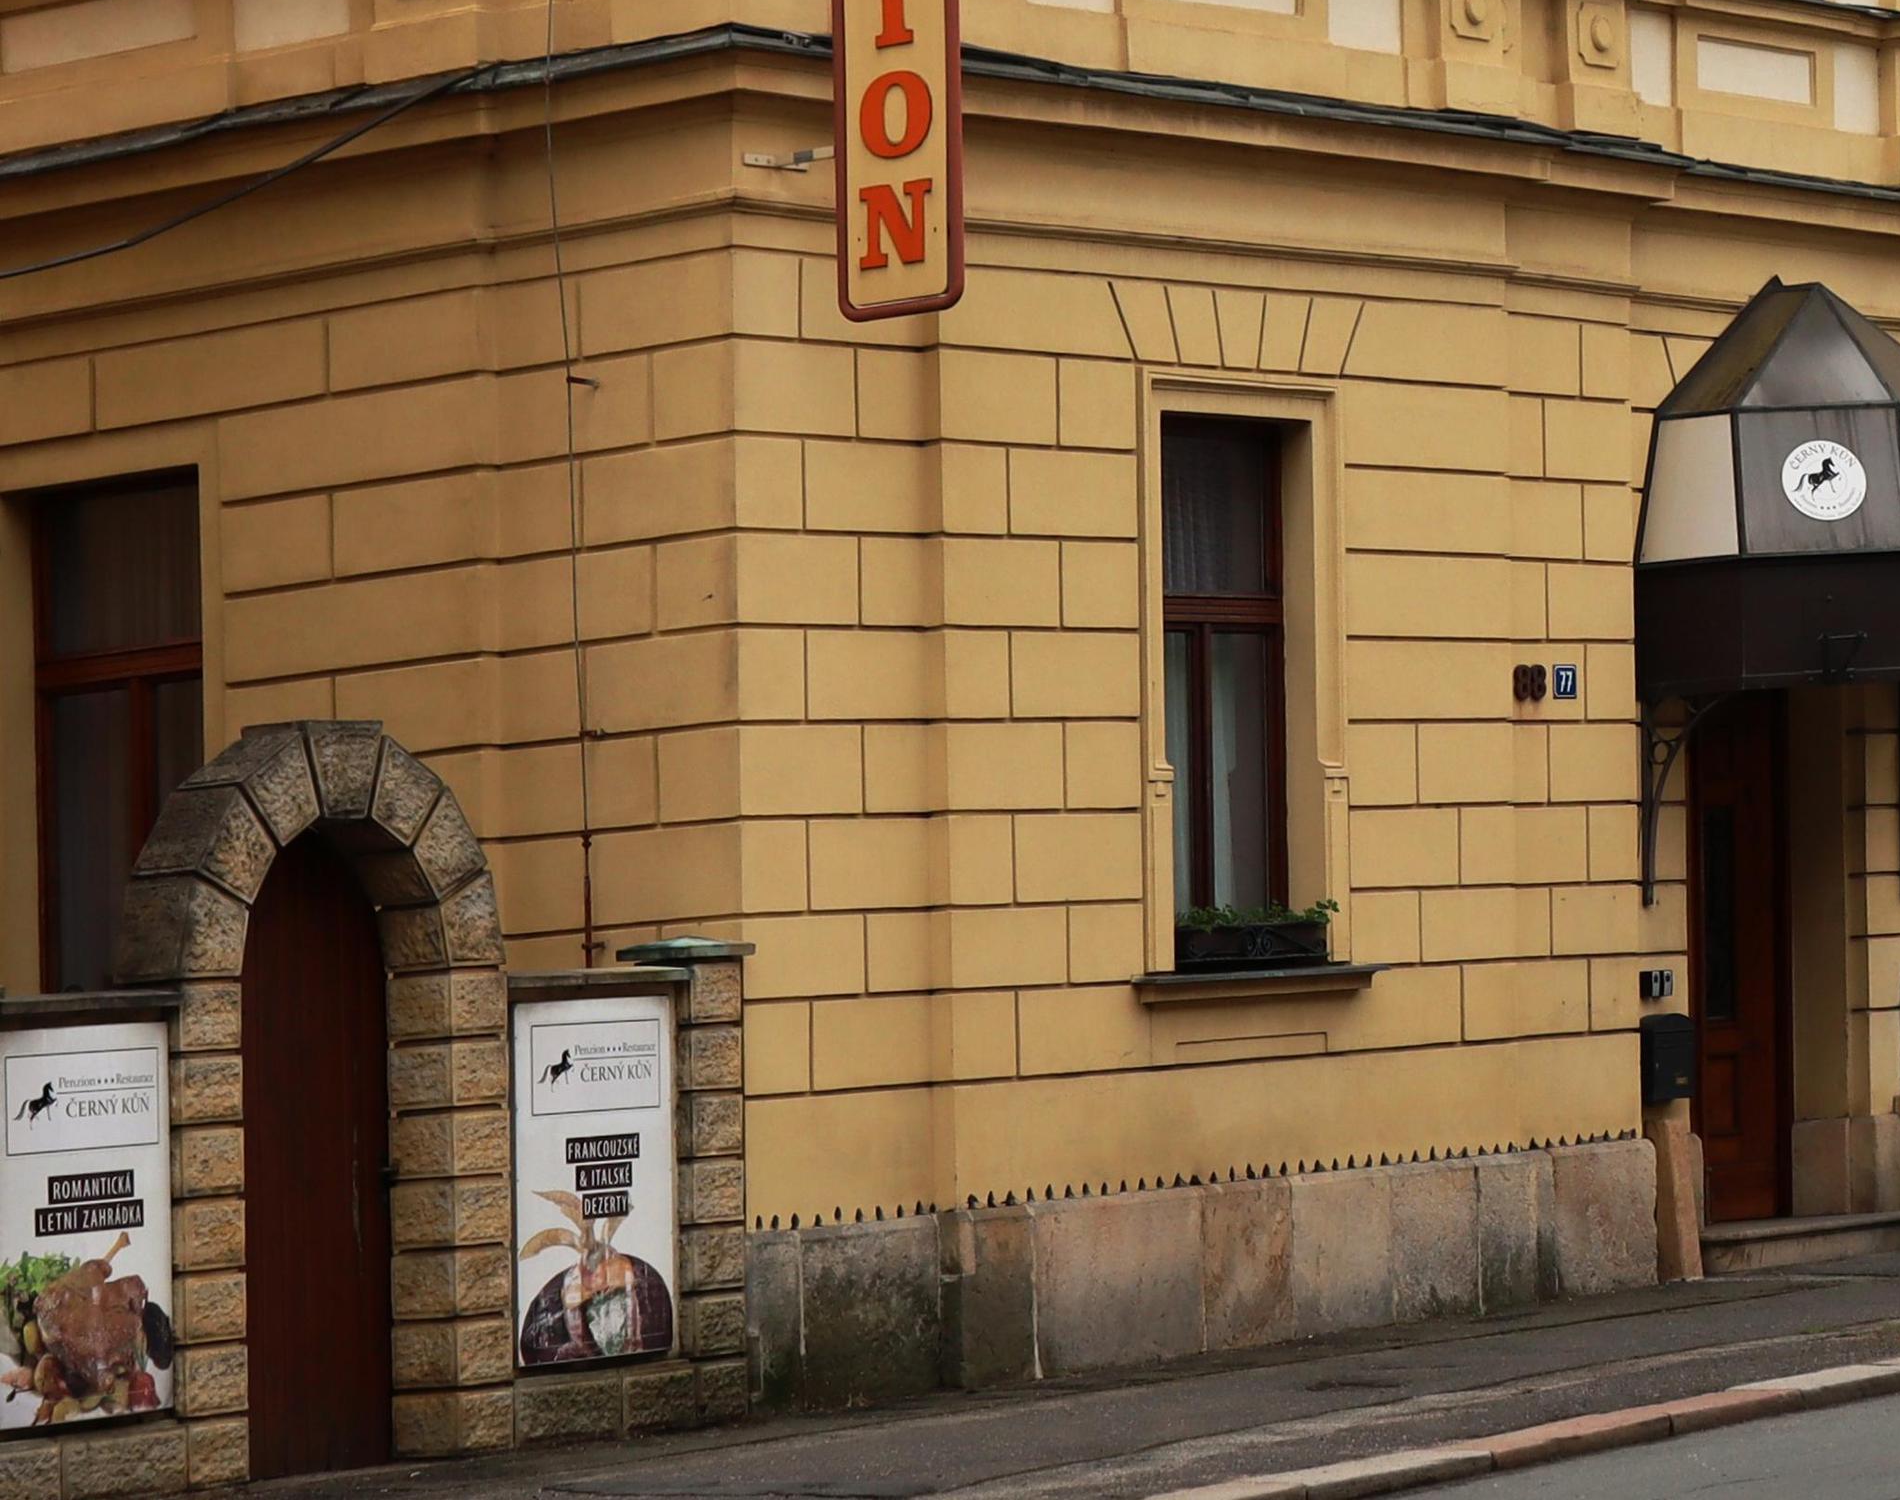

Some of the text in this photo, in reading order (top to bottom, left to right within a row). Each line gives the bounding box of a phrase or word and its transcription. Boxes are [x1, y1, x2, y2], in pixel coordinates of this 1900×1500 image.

[1513, 664, 1547, 702] 88
[1559, 670, 1573, 693] 77
[580, 1059, 652, 1082] ČERNÝ KŮŇ
[65, 1091, 150, 1118] ČERNÝ KŮŇ
[568, 1135, 638, 1160] FRANCOUZSKÉ
[53, 1172, 132, 1200] ROMANTICKÁ
[579, 1164, 630, 1187] & ITALSKÉ
[584, 1195, 627, 1215] DEZERTY
[39, 1203, 142, 1233] LETNÍ ZAHRÁDKA
